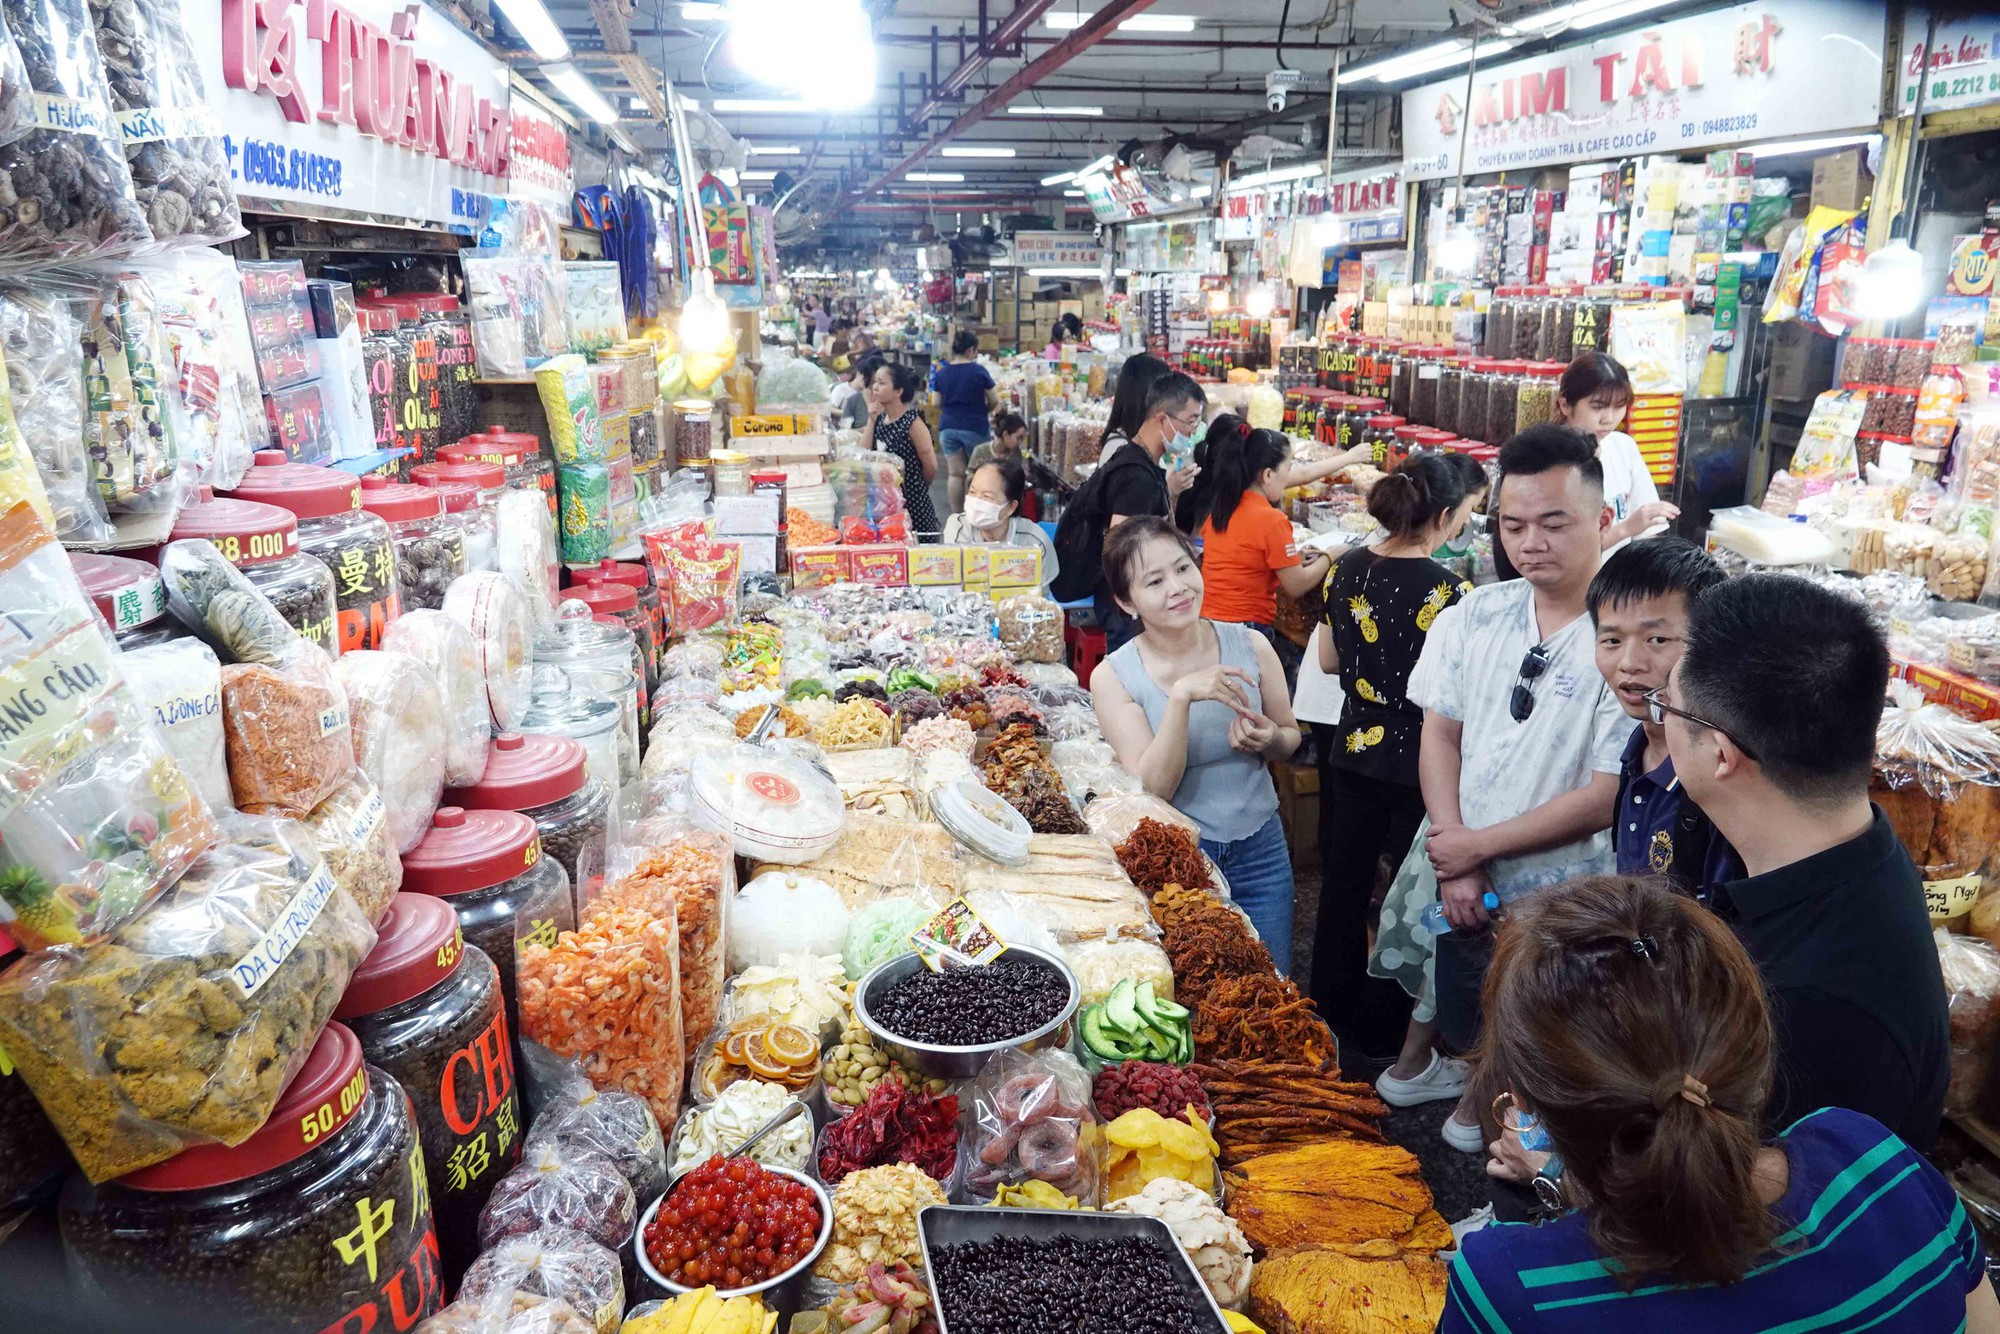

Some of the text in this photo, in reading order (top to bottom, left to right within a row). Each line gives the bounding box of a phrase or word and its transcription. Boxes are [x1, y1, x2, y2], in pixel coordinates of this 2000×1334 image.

[1931, 75, 1985, 99] 08.2212
[1703, 113, 1758, 135] 0948823829
[1577, 141, 1584, 153] &
[1586, 137, 1610, 153] CAFE
[1613, 134, 1634, 149] CAO
[243, 136, 342, 197] 0903.810358
[728, 242, 738, 275] SPAR
[1965, 254, 1990, 281] RITZ
[234, 955, 268, 990] DA
[264, 928, 292, 966] CÁ
[301, 1067, 366, 1144] 50.000
